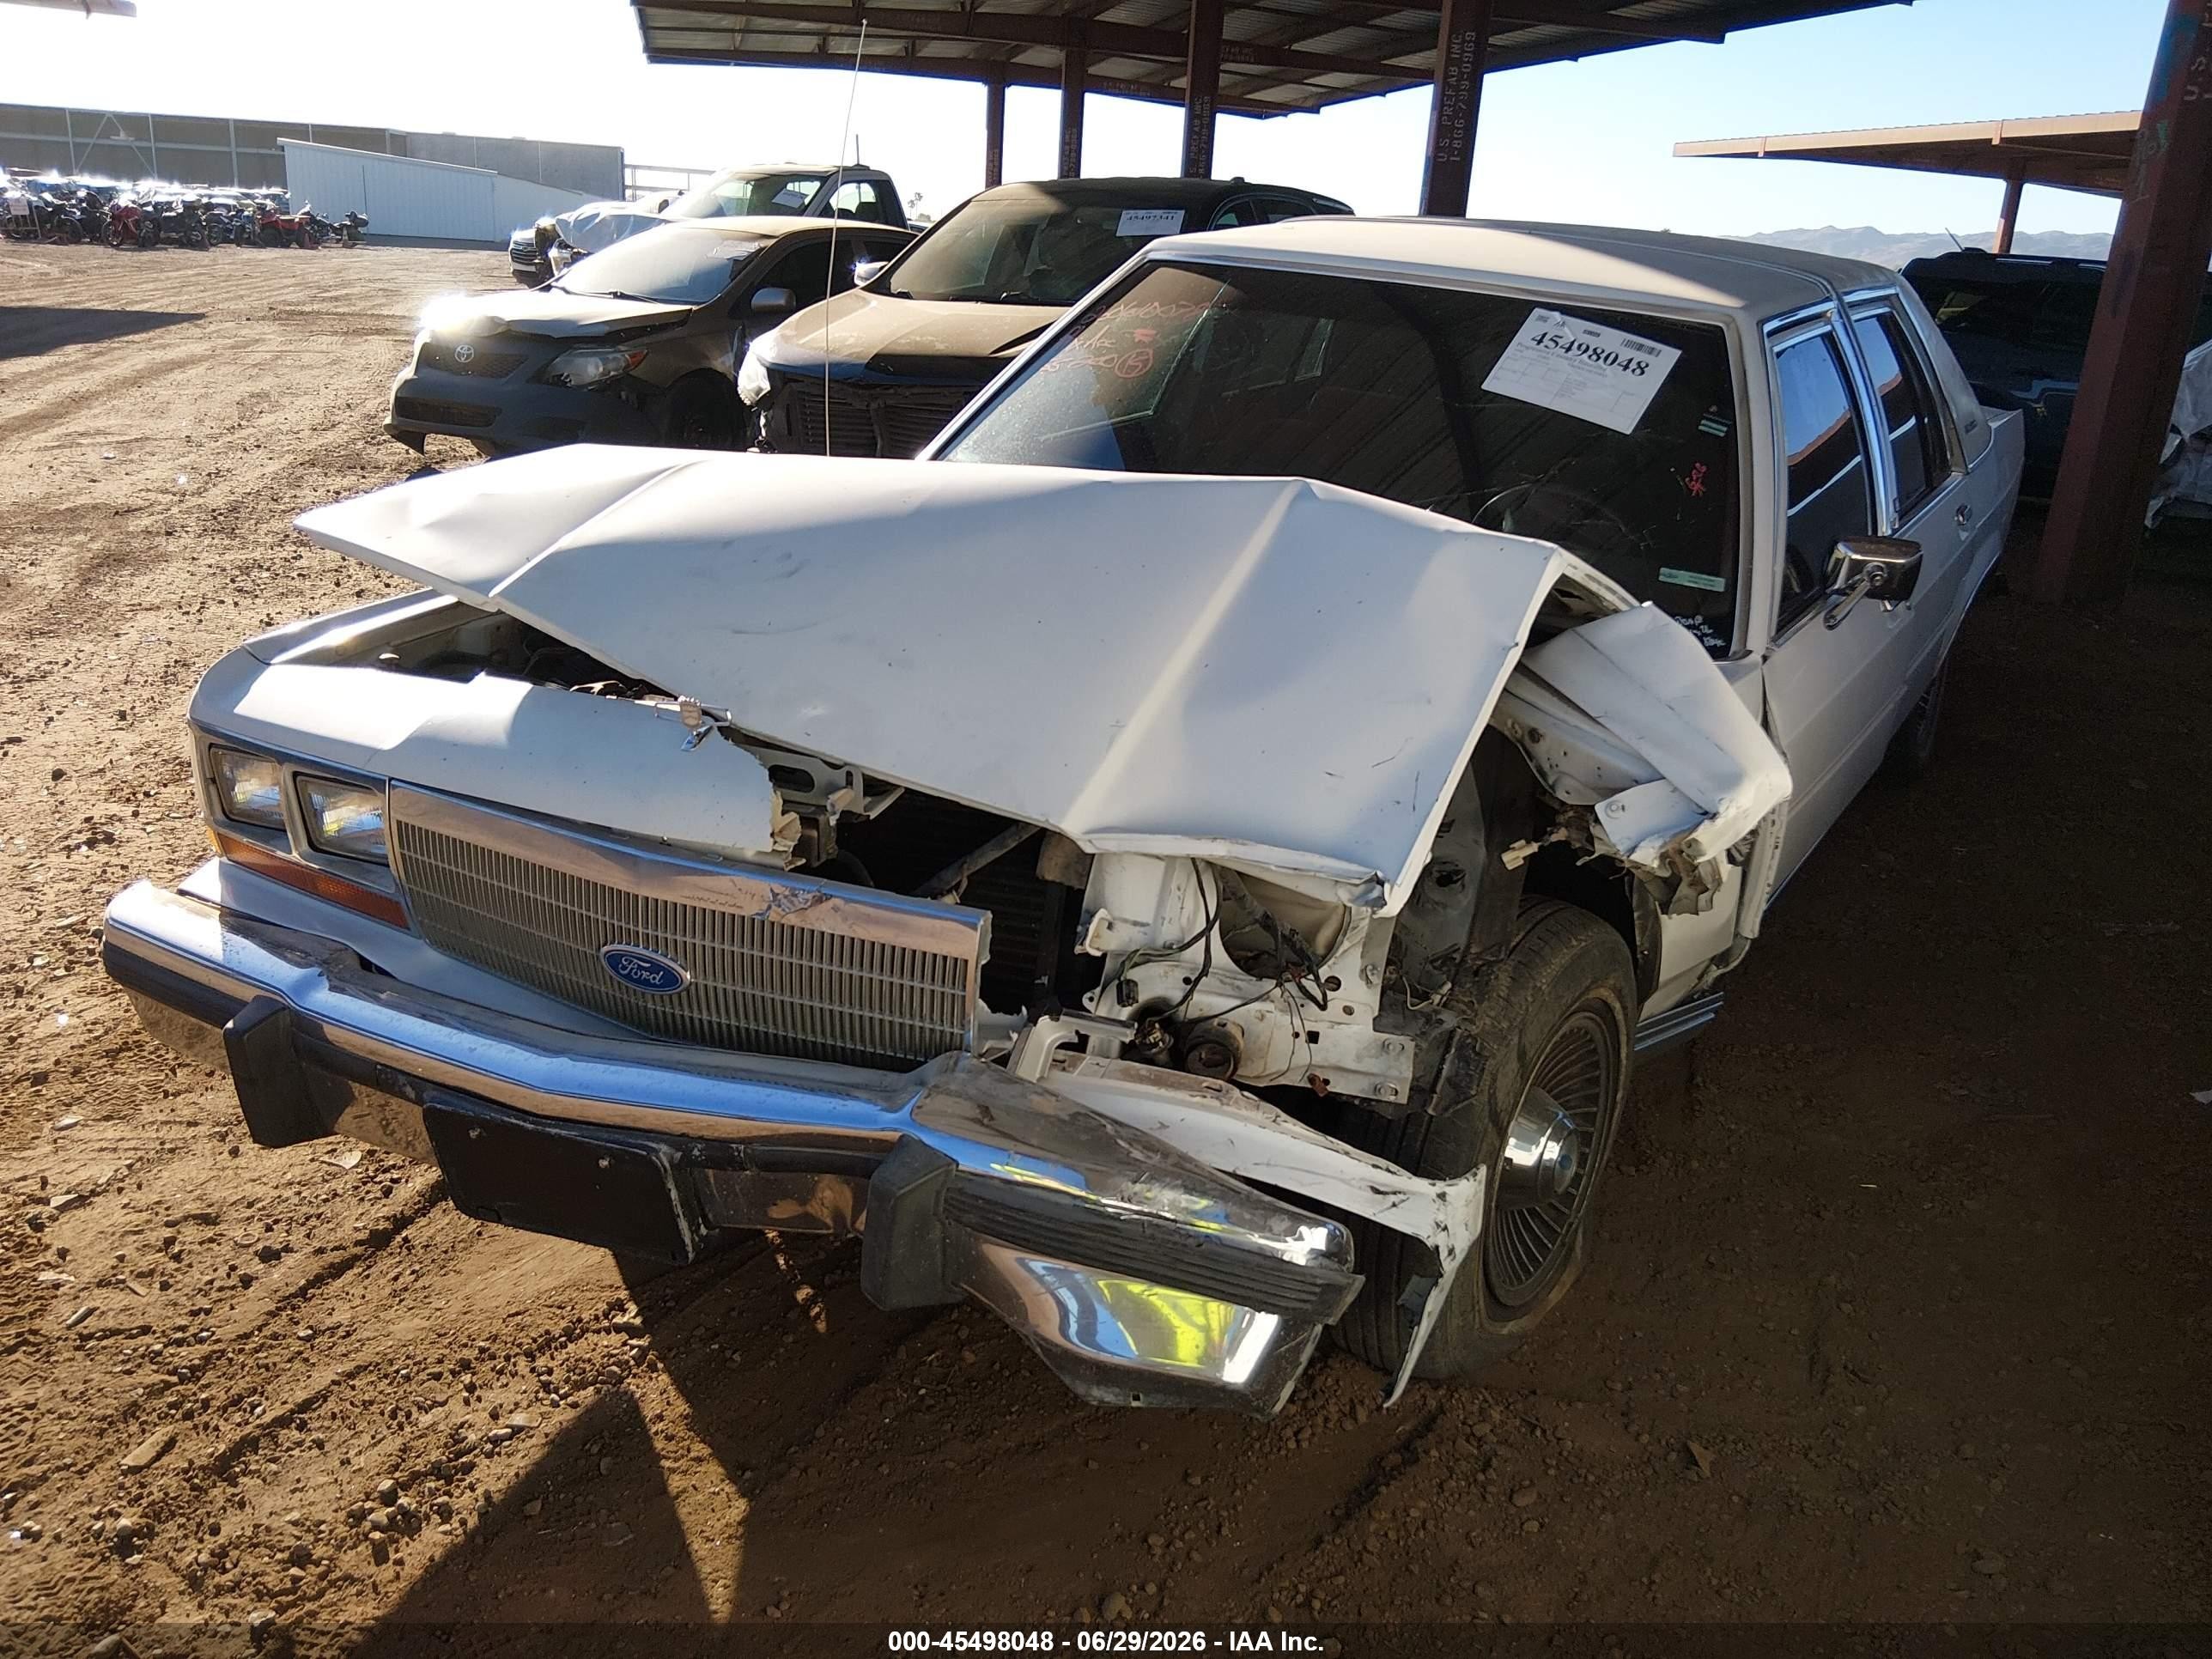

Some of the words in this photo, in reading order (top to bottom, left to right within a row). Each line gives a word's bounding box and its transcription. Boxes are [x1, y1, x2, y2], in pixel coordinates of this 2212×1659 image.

[1441, 65, 1459, 125] PREFAB
[1449, 31, 1476, 161] 1-866-799-0969
[1531, 331, 1650, 377] 45498048
[618, 957, 664, 985] Ford
